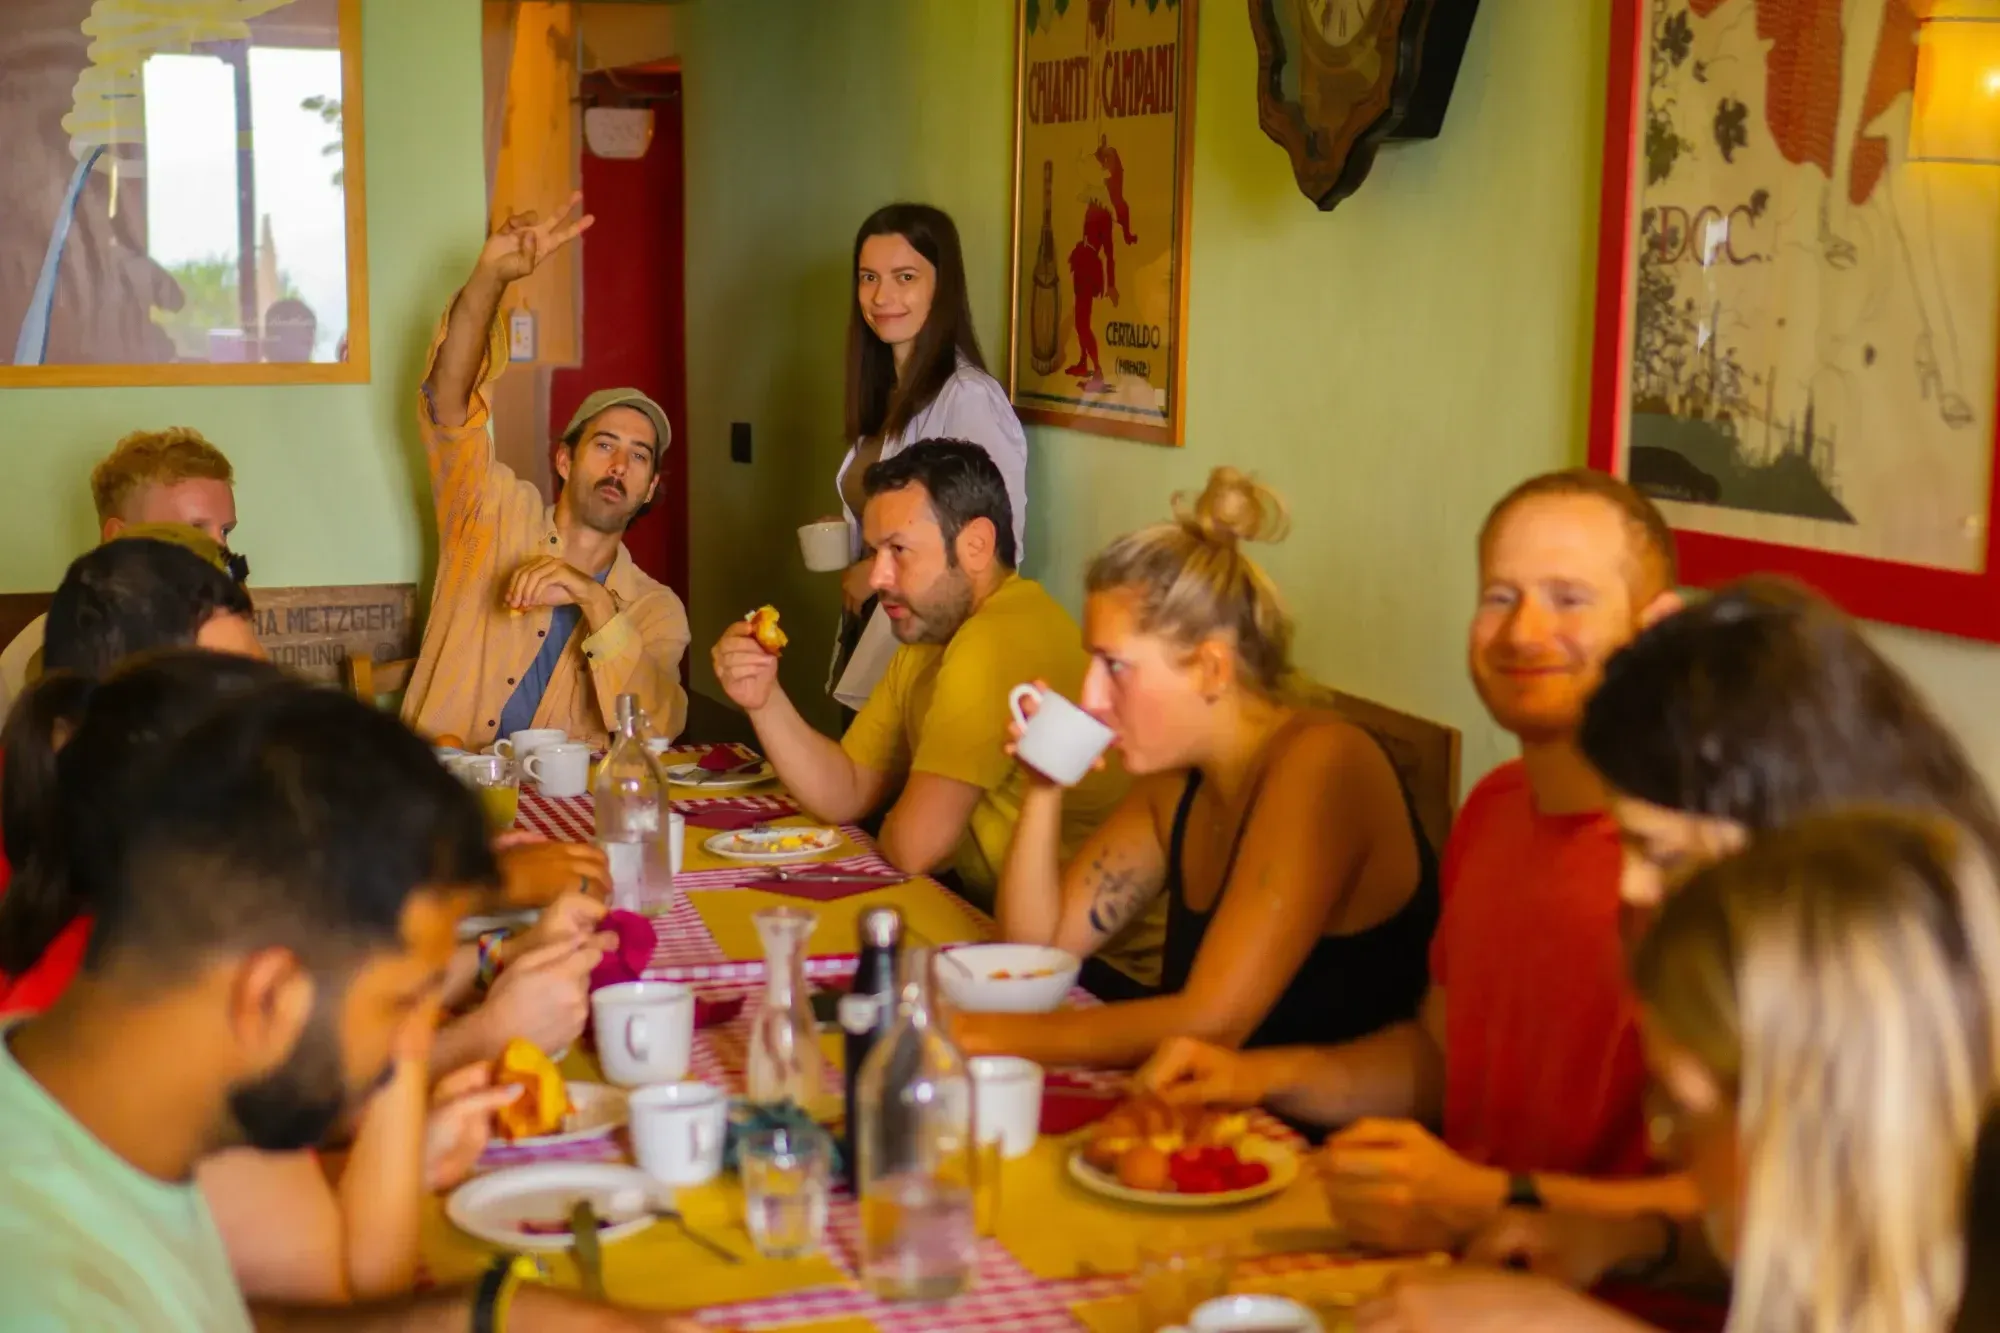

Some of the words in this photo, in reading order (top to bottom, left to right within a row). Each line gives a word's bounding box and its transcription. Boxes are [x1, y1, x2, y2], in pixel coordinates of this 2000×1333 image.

[1106, 322, 1160, 349] CERTALDO
[286, 604, 395, 634] METZGER
[269, 643, 345, 667] TORINO
